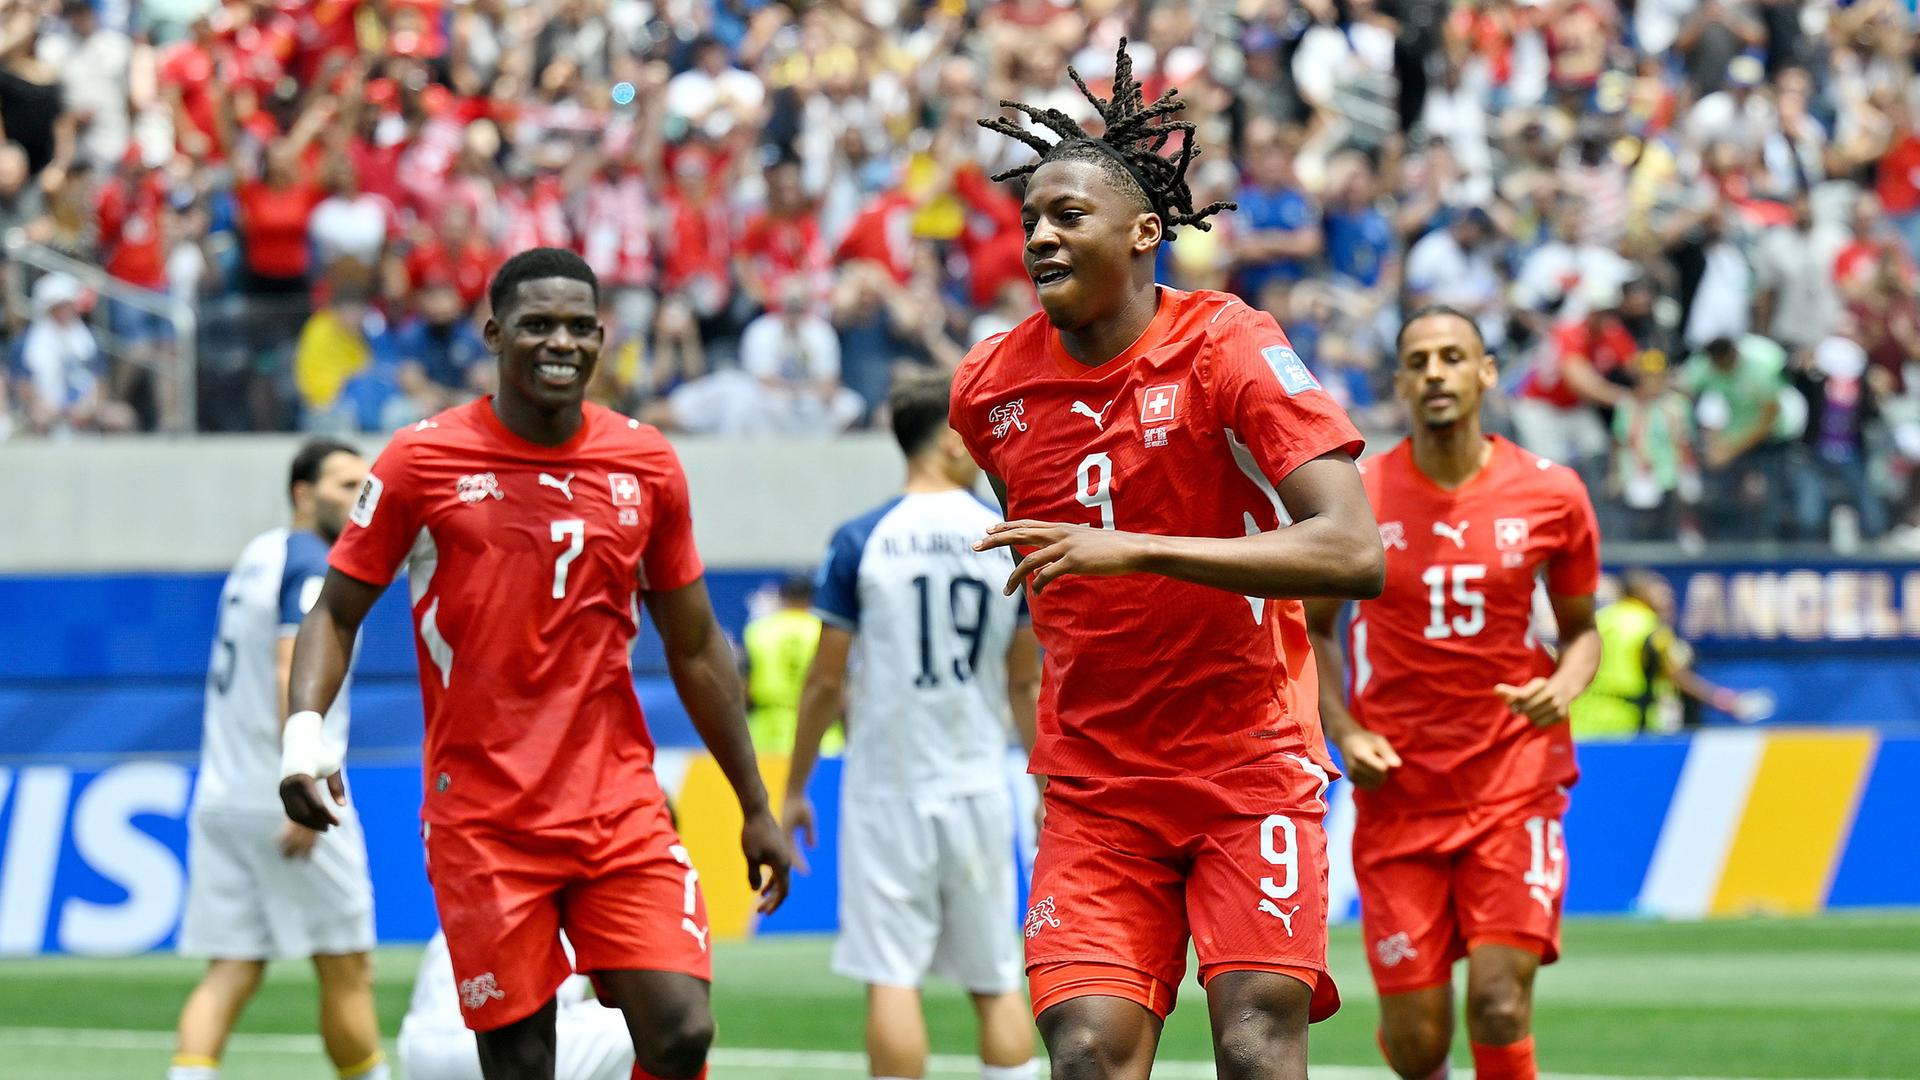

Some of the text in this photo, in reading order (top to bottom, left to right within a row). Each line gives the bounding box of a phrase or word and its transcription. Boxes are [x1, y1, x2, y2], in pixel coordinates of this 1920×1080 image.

[1075, 452, 1116, 531] 9
[550, 519, 585, 600] 7
[912, 575, 991, 689] 19
[1422, 563, 1487, 640] 15
[0, 761, 189, 957] IS
[668, 845, 699, 916] 7
[1260, 814, 1299, 899] 9
[1523, 815, 1563, 892] 15
